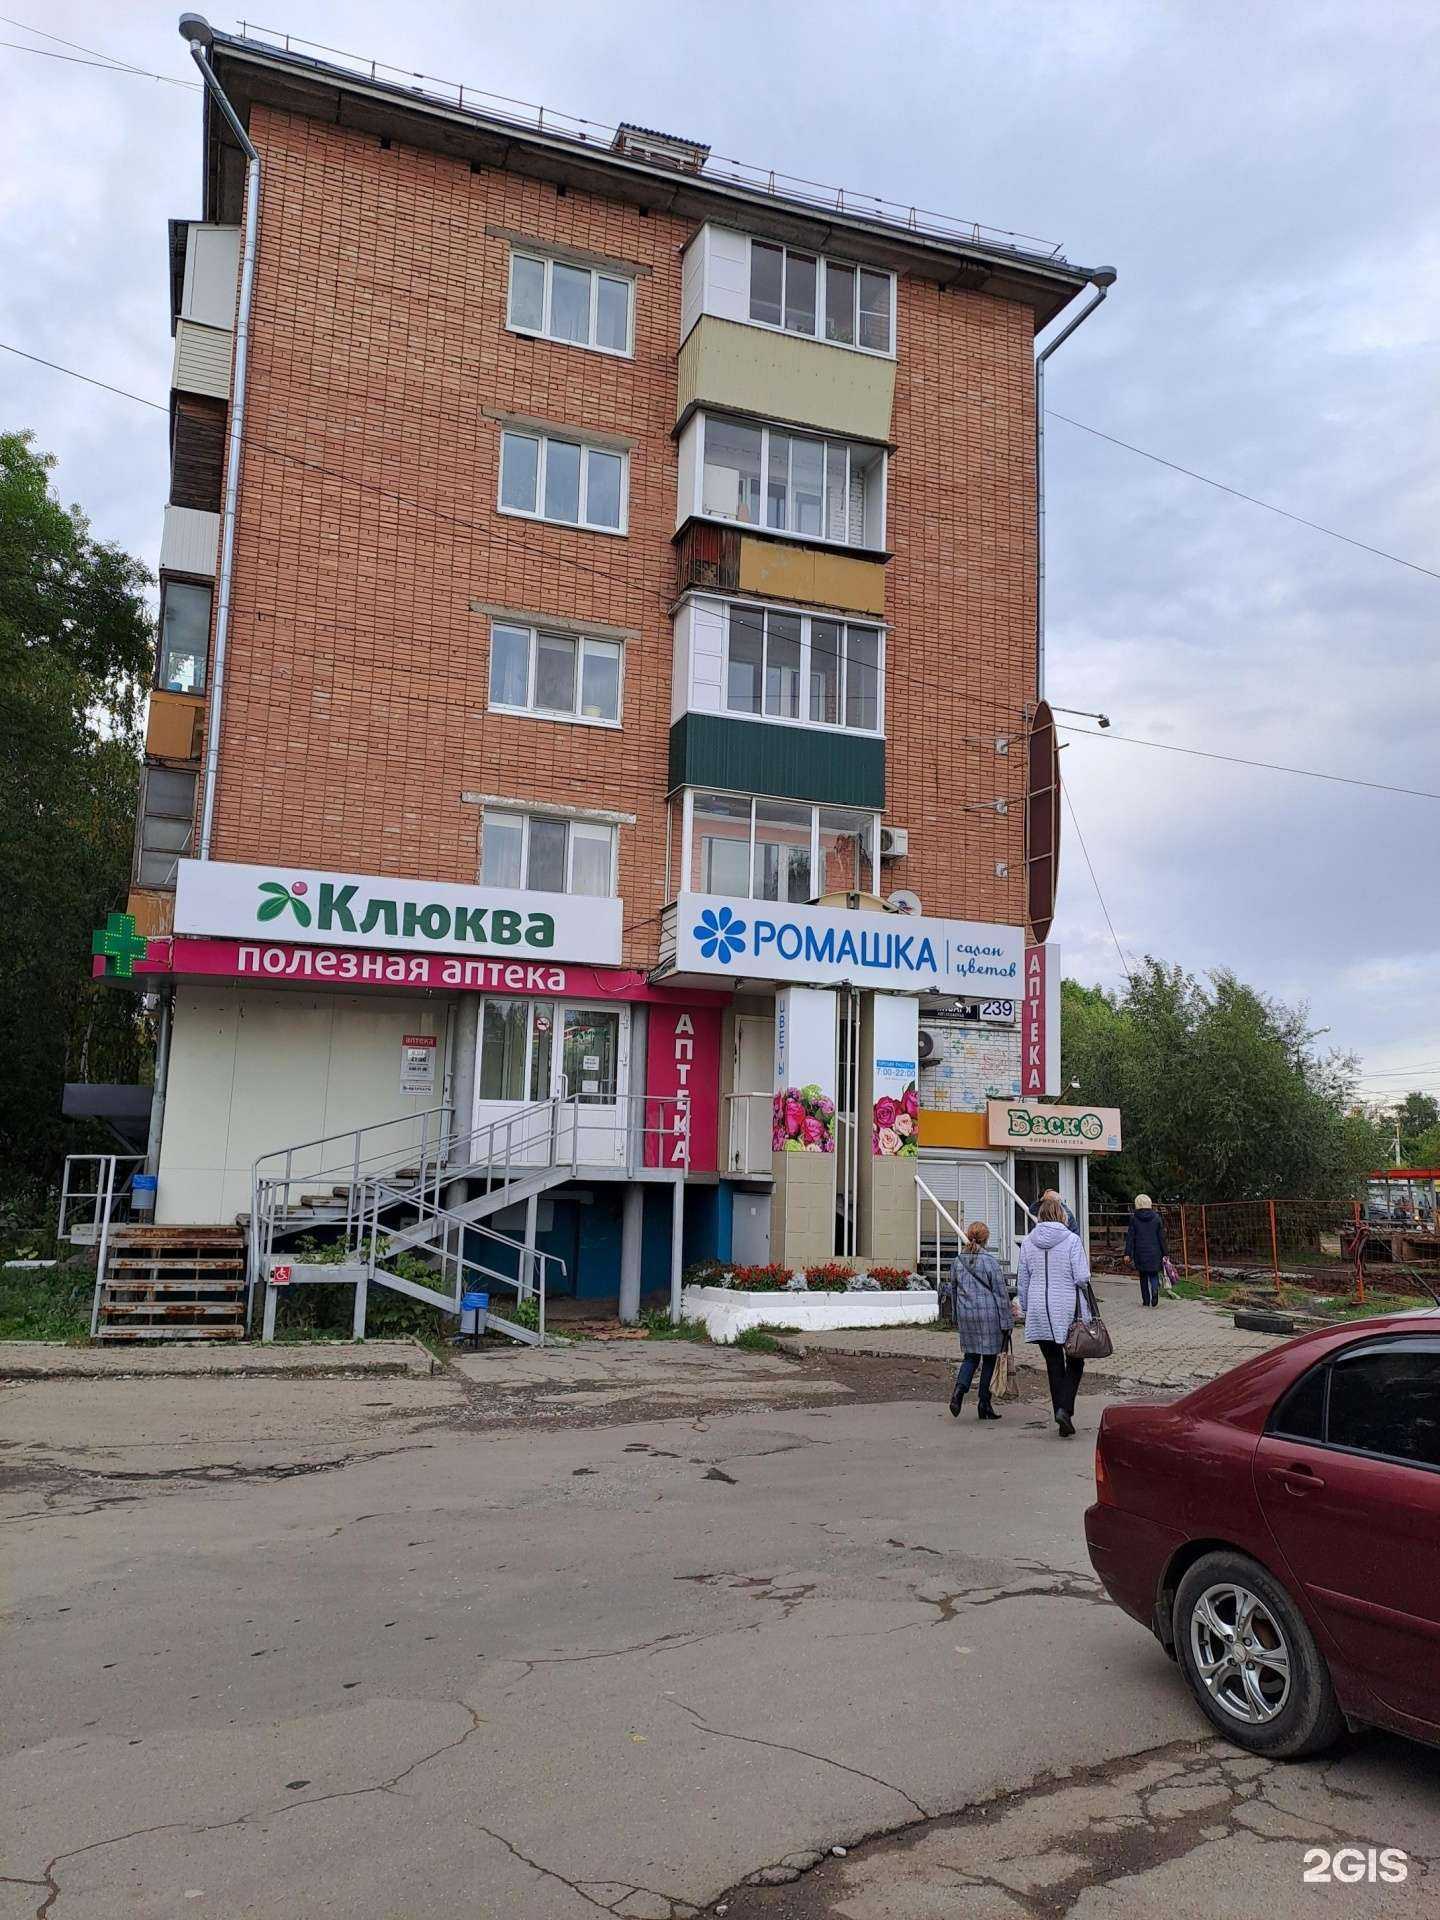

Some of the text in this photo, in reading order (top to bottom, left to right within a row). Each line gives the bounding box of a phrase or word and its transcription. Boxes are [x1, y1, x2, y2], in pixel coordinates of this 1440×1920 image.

[317, 883, 555, 948] Клюква
[237, 946, 566, 991] полезная аптека
[754, 920, 938, 973] РОМАШКА
[956, 943, 1004, 957] салон
[956, 961, 1017, 978] цветов
[983, 1000, 1013, 1016] 239
[1028, 954, 1041, 1089] АПТЕКА
[671, 1013, 695, 1162] АПТЕКА
